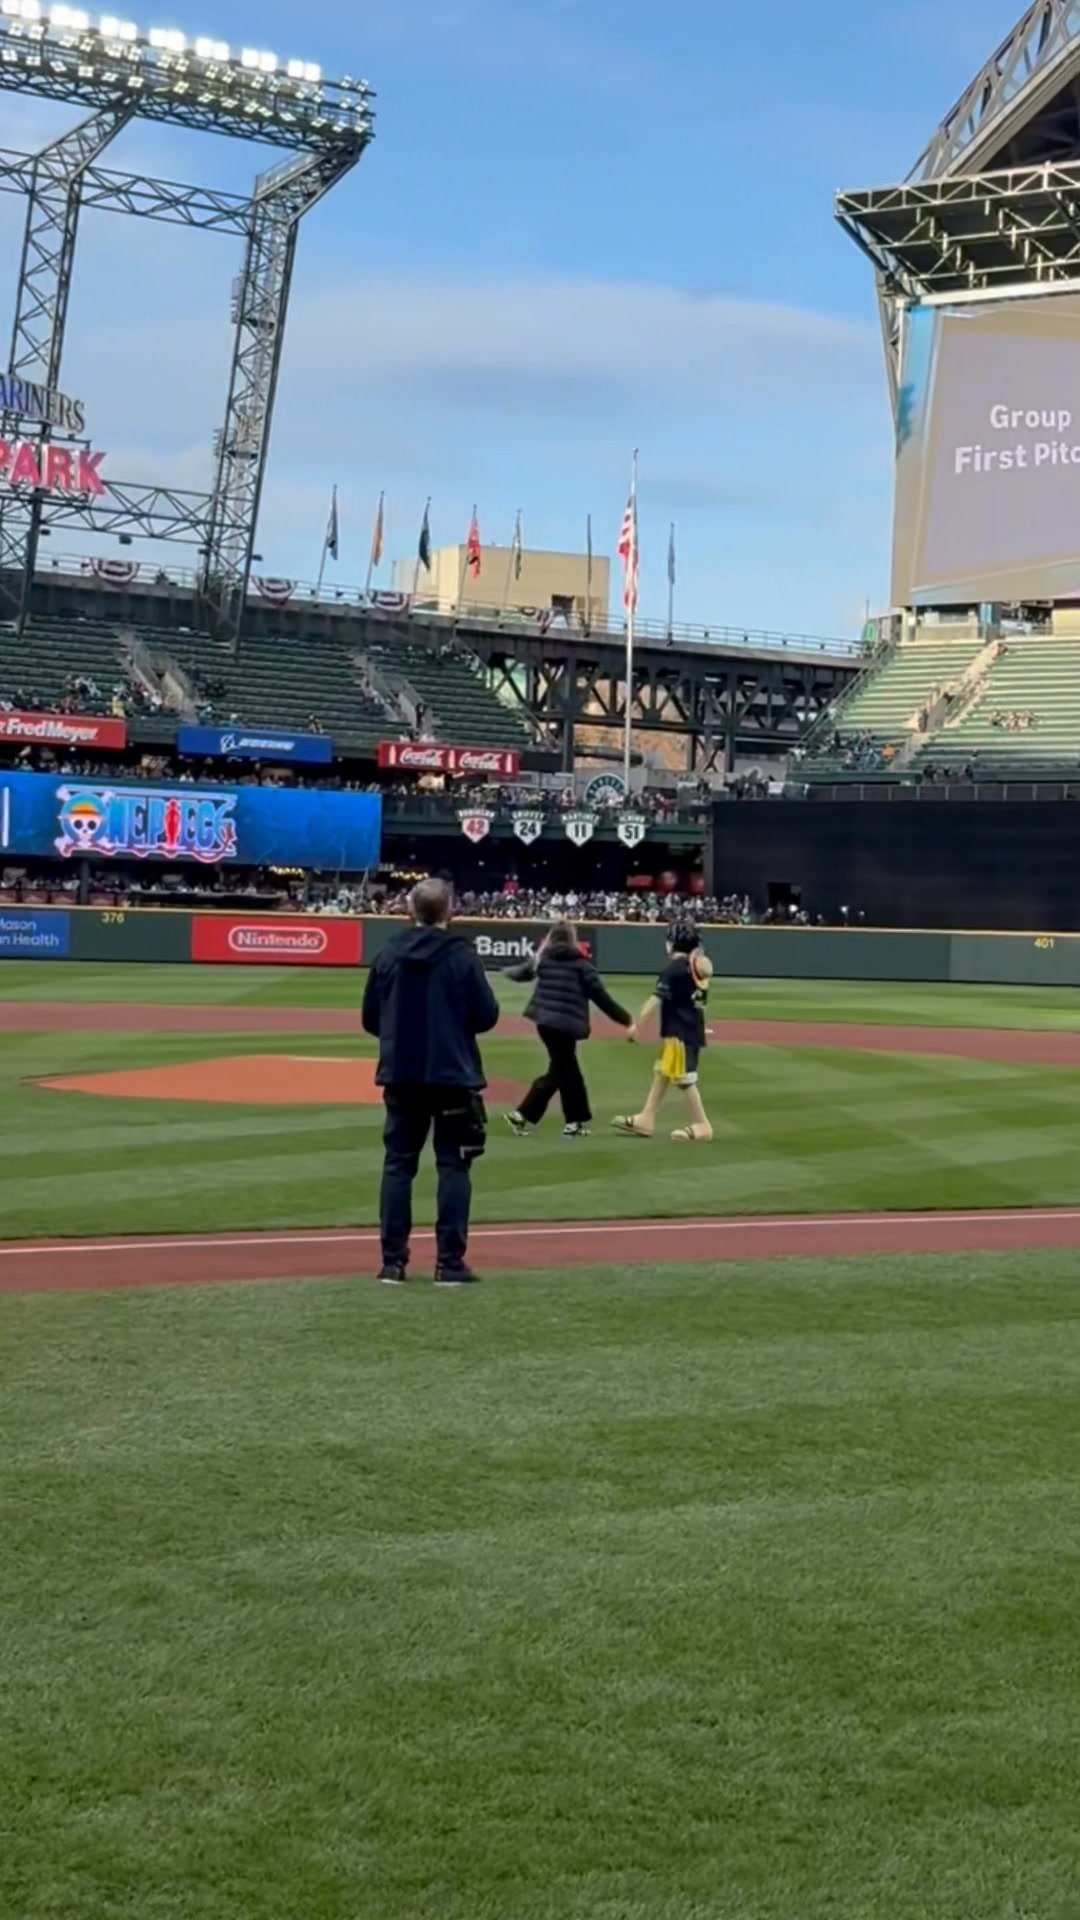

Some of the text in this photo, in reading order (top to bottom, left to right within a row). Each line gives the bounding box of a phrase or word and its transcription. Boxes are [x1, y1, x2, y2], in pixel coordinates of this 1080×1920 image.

[989, 404, 1072, 432] Group
[955, 444, 1028, 474] First
[466, 819, 486, 836] 42
[519, 821, 537, 837] 24
[574, 823, 587, 838] 11
[624, 825, 639, 840] 51
[101, 912, 125, 924] 376
[13, 933, 60, 946] Health
[237, 931, 319, 948] Nintendo
[474, 935, 536, 957] Bank
[1034, 937, 1055, 949] 401
